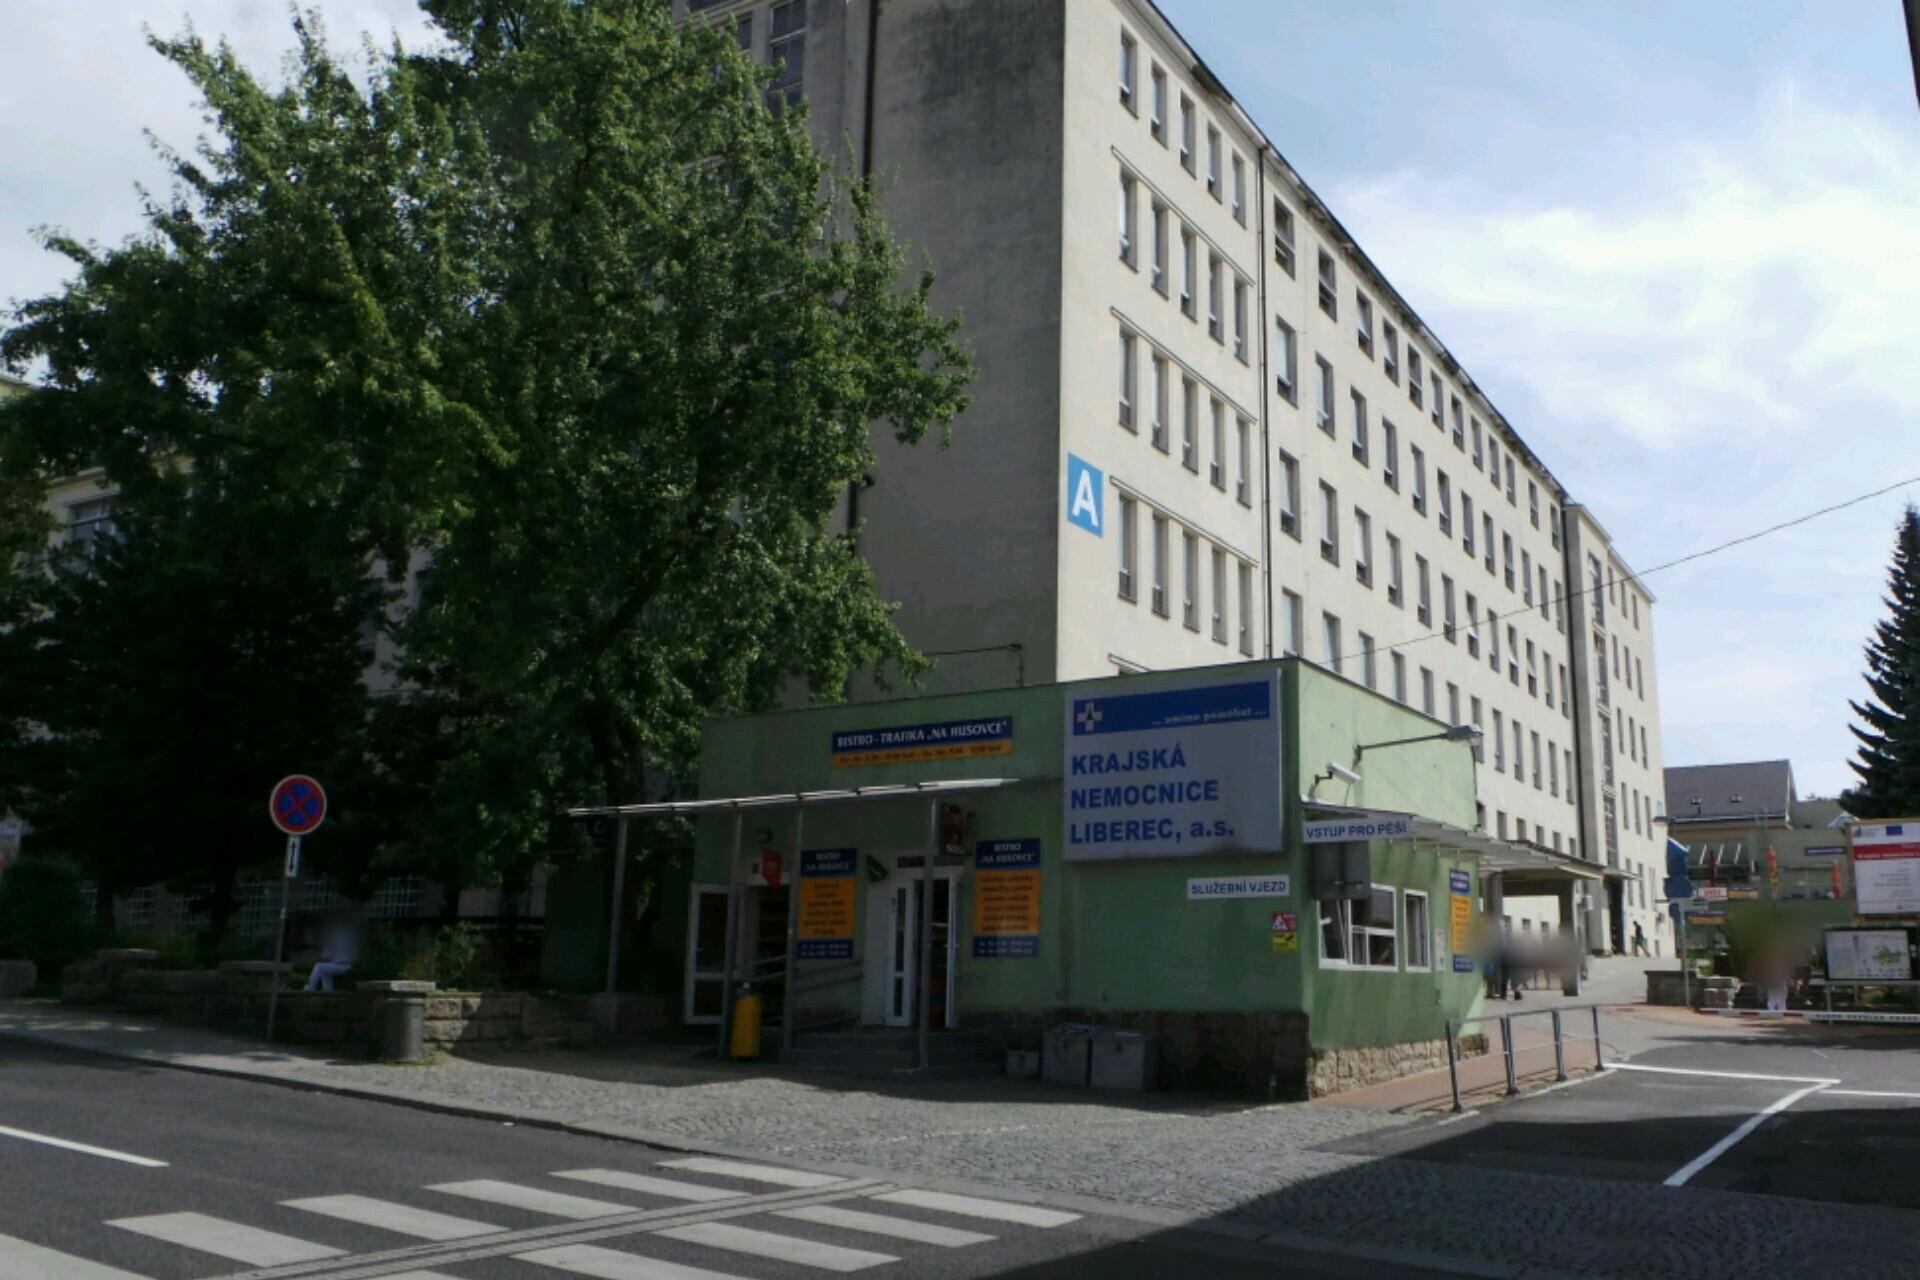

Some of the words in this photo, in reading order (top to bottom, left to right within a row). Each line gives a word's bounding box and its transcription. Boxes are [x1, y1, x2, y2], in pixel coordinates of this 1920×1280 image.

[1071, 468, 1099, 528] A
[837, 734, 873, 747] BISTRO
[880, 729, 925, 744] TRAFIKA
[1071, 742, 1187, 776] KRAJSKÁ
[1071, 779, 1219, 810] NEMOCNICE
[1070, 818, 1182, 844] LIBEREC,
[1190, 820, 1235, 838] a.s.
[1306, 825, 1346, 839] VSTUP
[1348, 824, 1376, 837] PRO
[1191, 880, 1247, 895] SLUŽEBNÍ
[1249, 880, 1287, 893] VJEZD
